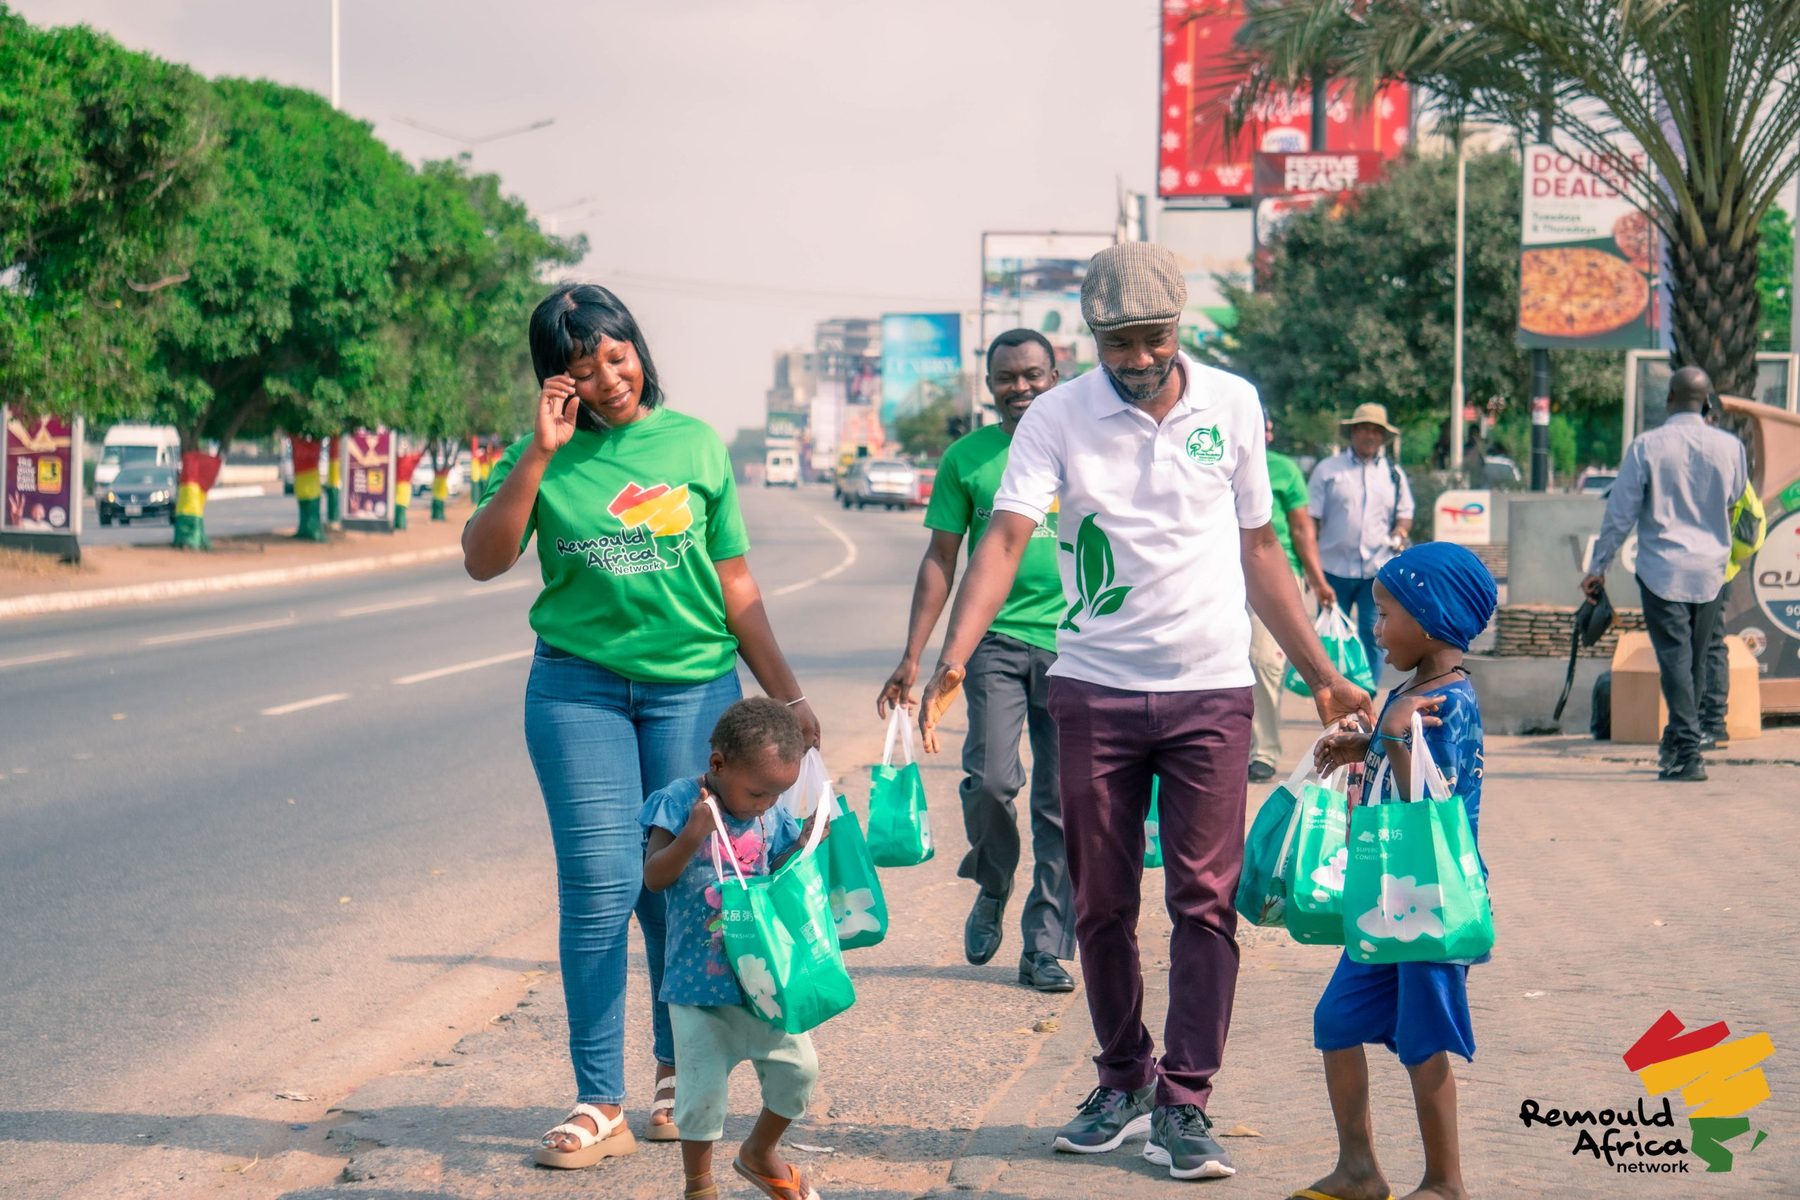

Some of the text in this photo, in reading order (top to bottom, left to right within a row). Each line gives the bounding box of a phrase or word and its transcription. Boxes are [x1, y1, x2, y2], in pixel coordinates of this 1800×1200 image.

[1285, 155, 1358, 173] FESTIVE
[1284, 174, 1357, 191] FEAST
[556, 526, 646, 555] Remould
[587, 547, 656, 571] Africa
[613, 561, 662, 576] Network
